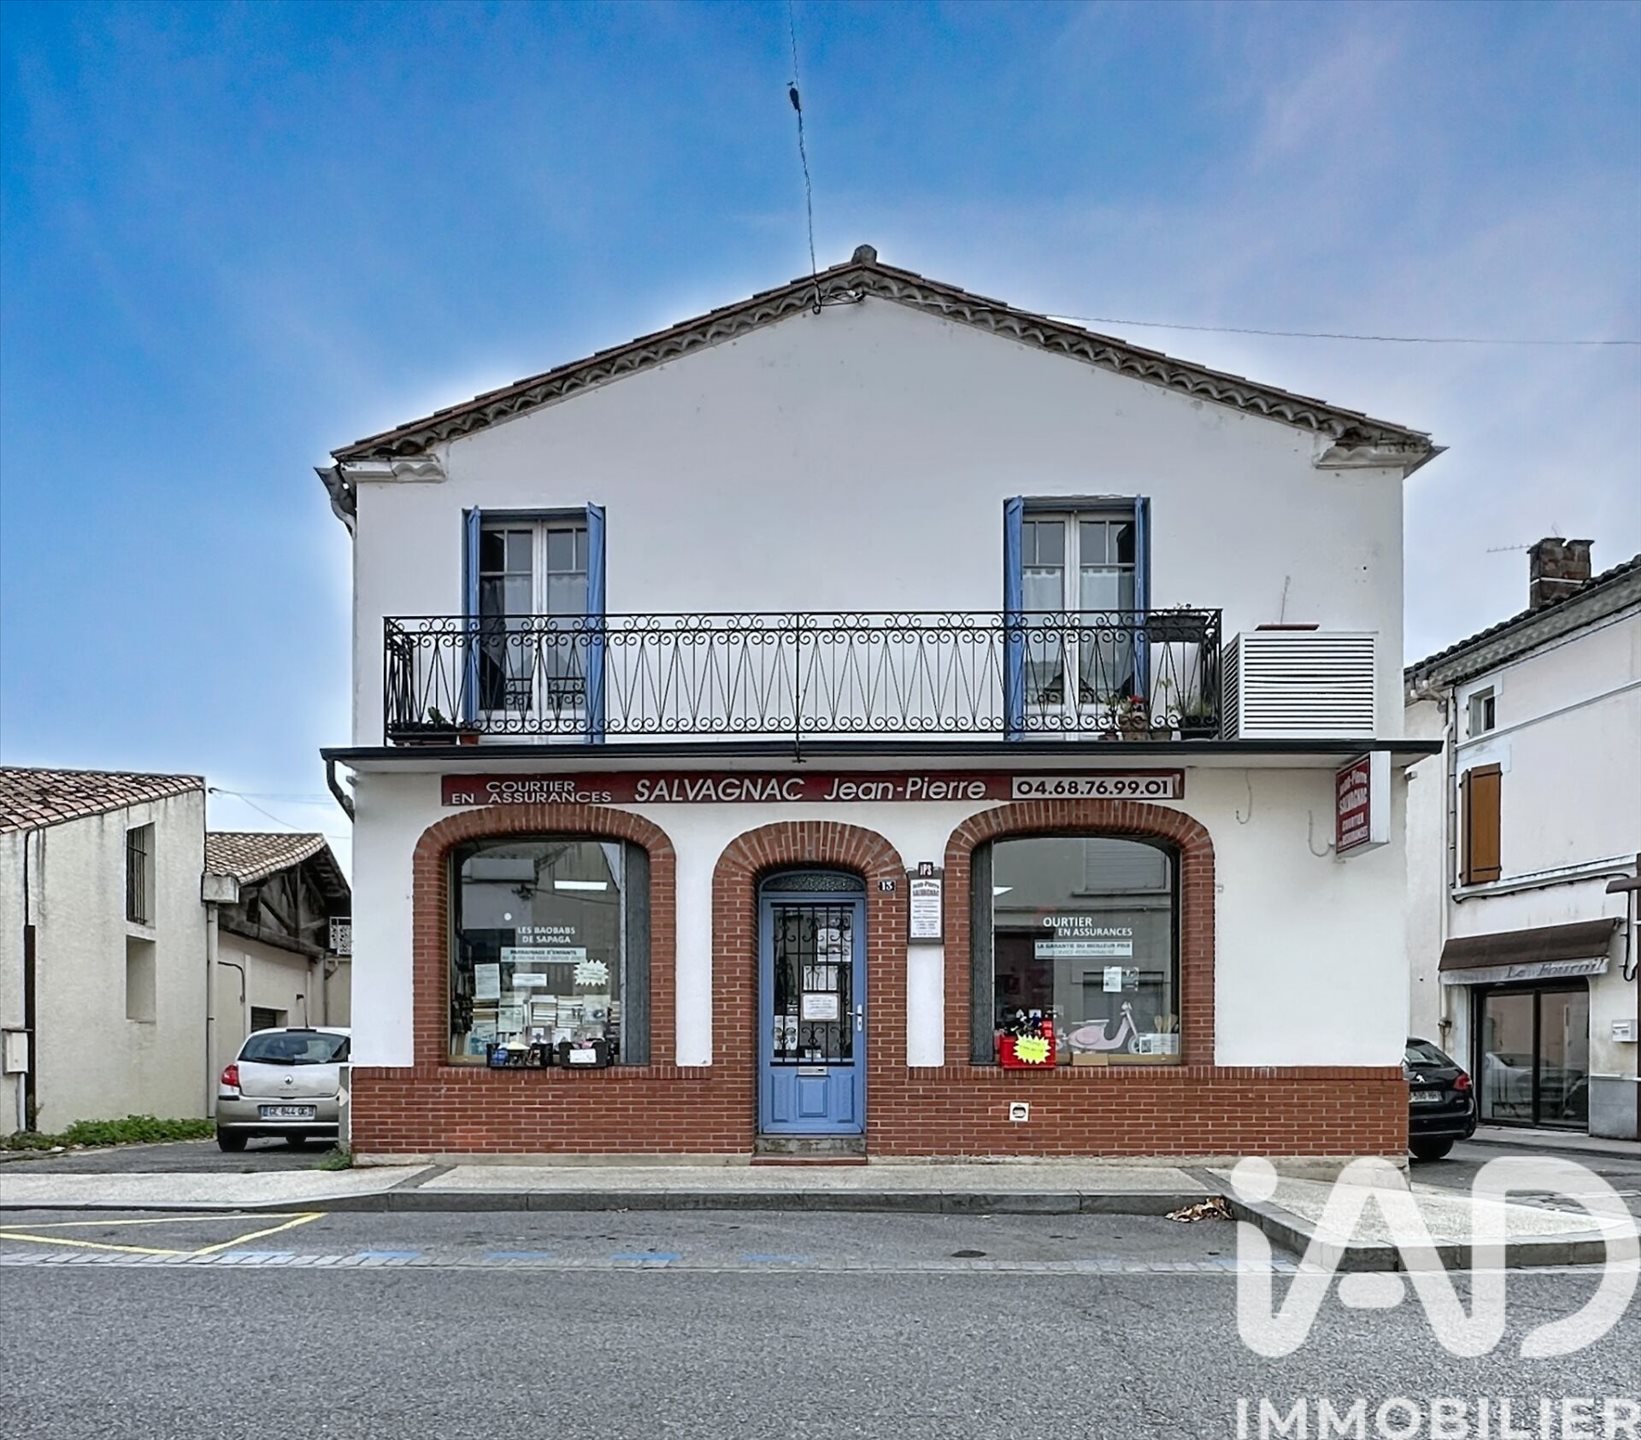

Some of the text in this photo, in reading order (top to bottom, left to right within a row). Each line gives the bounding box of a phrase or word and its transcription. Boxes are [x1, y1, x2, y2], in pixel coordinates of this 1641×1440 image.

[485, 780, 576, 793] COURTIER
[634, 777, 987, 802] SALVAGNAC Jean-Pierre
[1016, 779, 1169, 797] 04.68.76.99.01
[452, 791, 612, 805] EN ASSURANCES
[1042, 916, 1093, 928] OURTIER
[517, 926, 576, 935] LES BAOBABS
[1058, 927, 1133, 937] EN ASSURANCES
[522, 935, 571, 943] DE SAPAGA
